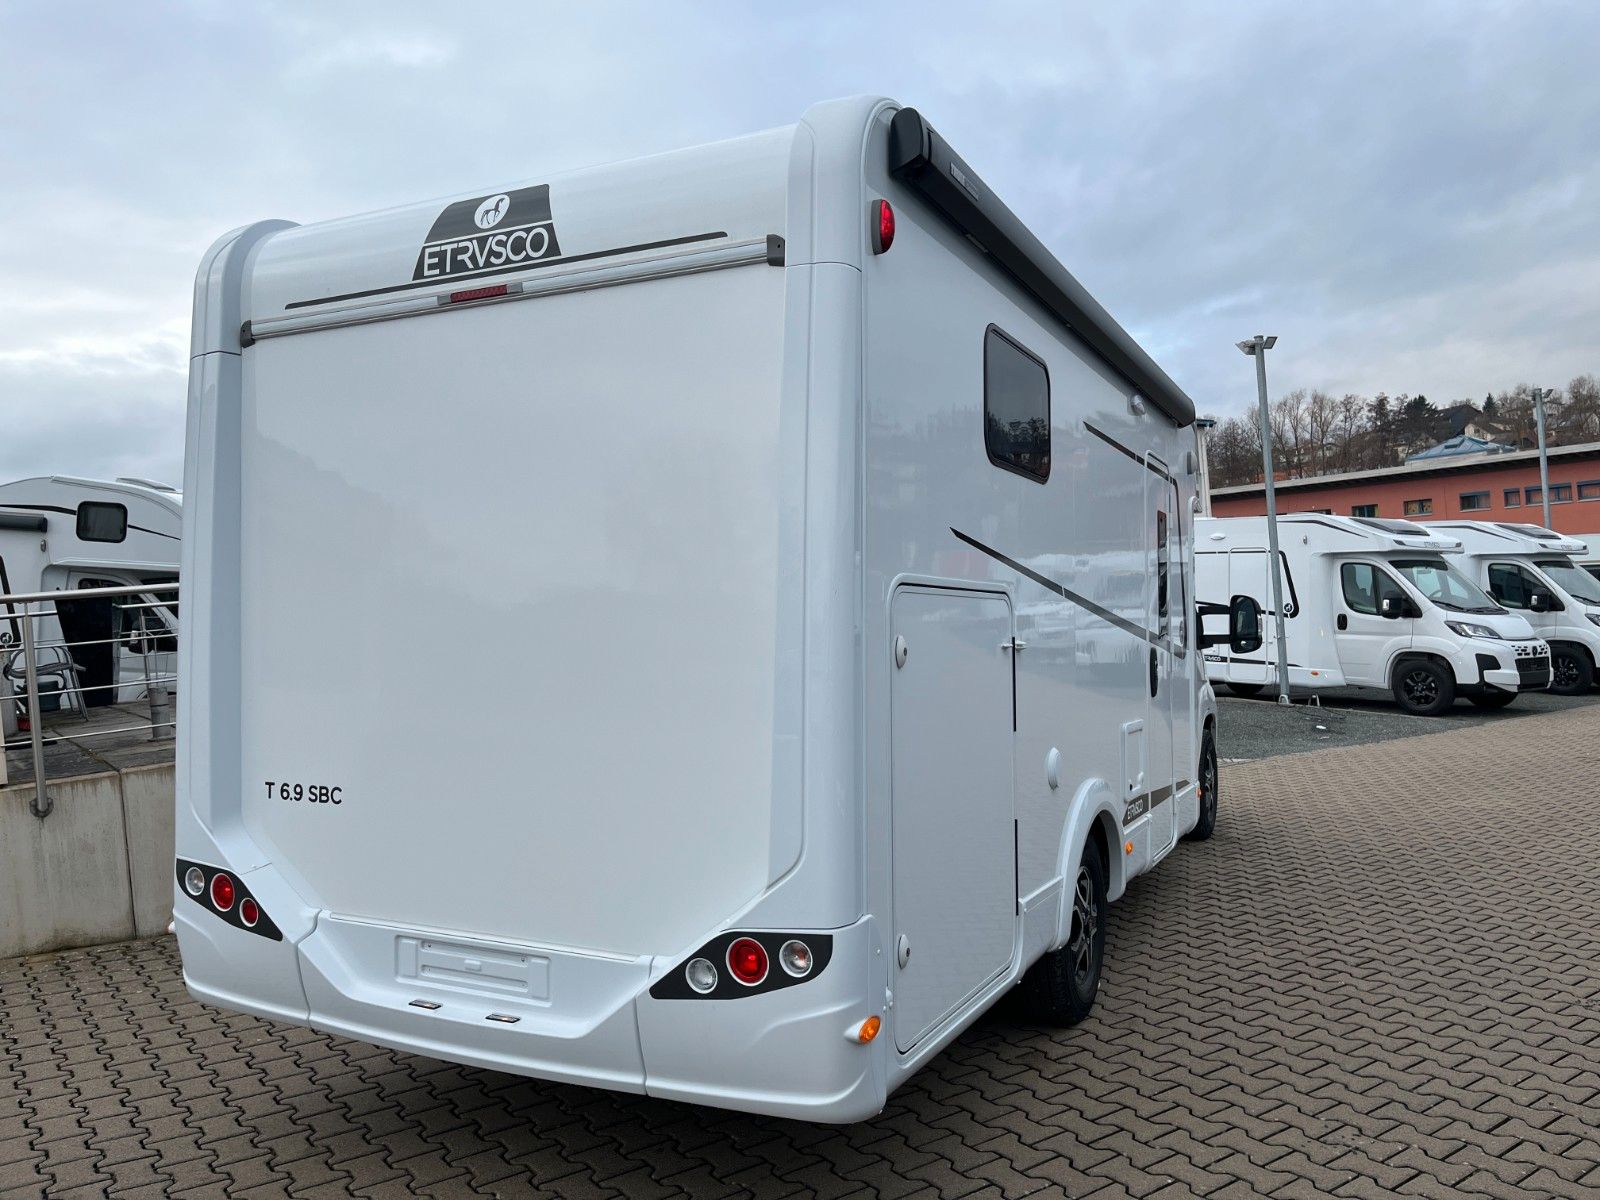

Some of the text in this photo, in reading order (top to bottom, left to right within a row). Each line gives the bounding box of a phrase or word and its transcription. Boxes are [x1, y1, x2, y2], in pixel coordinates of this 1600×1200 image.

[265, 781, 343, 805] T 6.9 SBC
